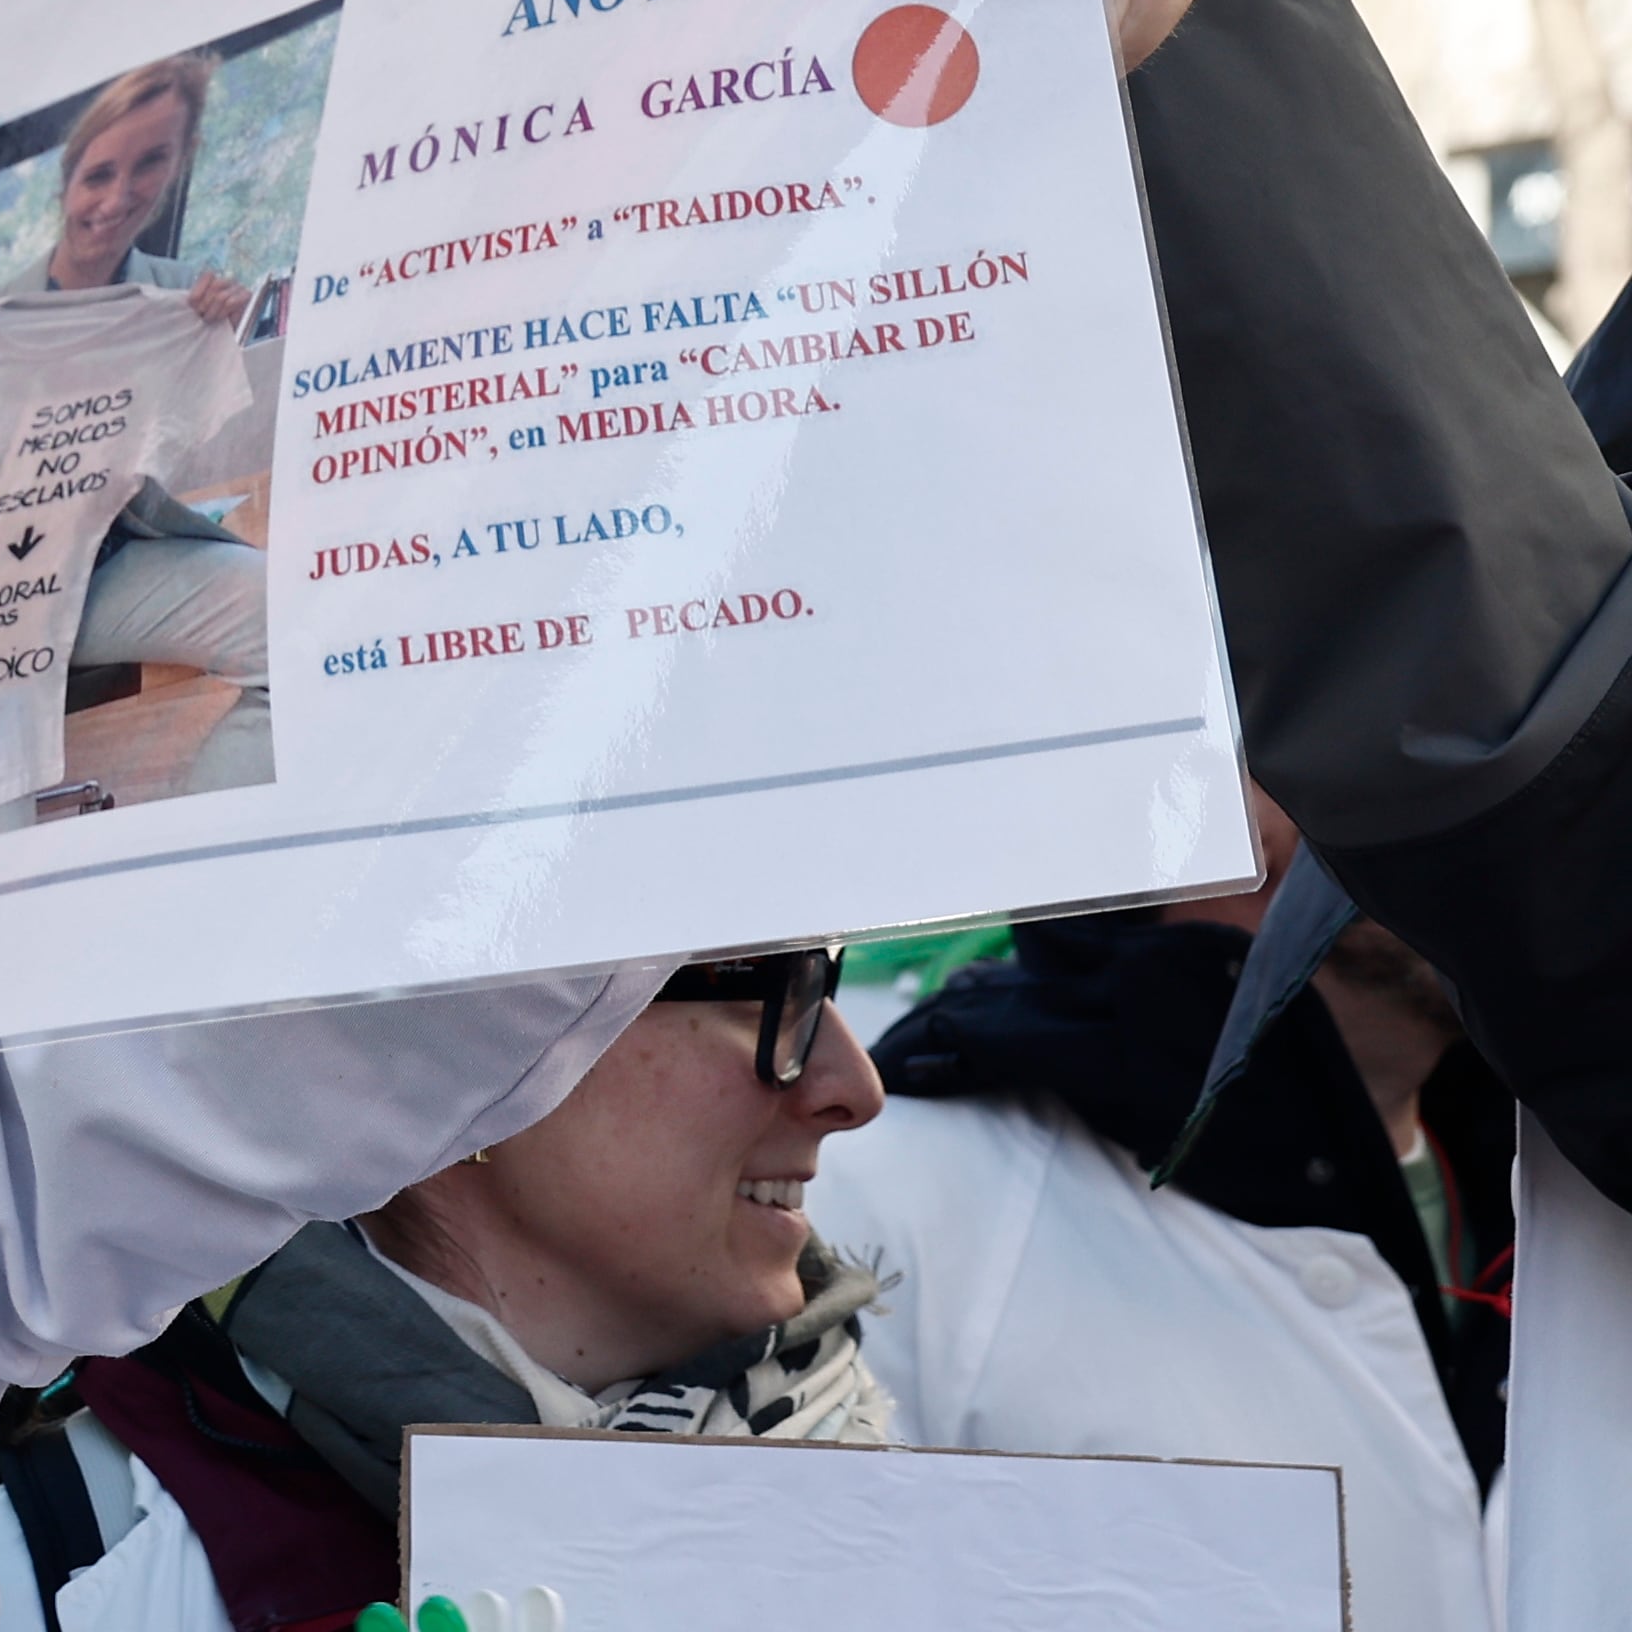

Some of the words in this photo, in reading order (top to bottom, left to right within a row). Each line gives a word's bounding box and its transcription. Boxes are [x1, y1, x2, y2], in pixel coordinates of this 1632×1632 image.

[356, 97, 595, 190] MÓNICA
[640, 47, 835, 119] GARCÍA
[312, 274, 350, 305] De
[359, 215, 578, 288] “ACTIVISTA”
[587, 218, 604, 241] a
[293, 325, 513, 399] SOLAMENTE
[524, 307, 631, 350] HACE
[642, 290, 770, 334] FALTA
[776, 278, 857, 314] “UN
[869, 250, 1031, 306] SILLÓN
[31, 387, 133, 429] SOMOS
[313, 362, 579, 440] MINISTERIAL”
[590, 359, 669, 398] para
[679, 321, 907, 377] “CAMBIAR
[916, 311, 976, 350] DE
[36, 452, 81, 479] NO
[311, 422, 500, 486] OPINIÓN”,
[509, 424, 547, 451] en
[557, 400, 698, 446] MEDIA
[704, 384, 842, 428] HORA.
[309, 534, 442, 582] JUDAS,
[452, 528, 480, 560] A
[487, 518, 542, 555] TU
[553, 503, 685, 548] LADO,
[323, 639, 388, 676] está
[398, 622, 526, 668] LIBRE
[535, 614, 594, 651] DE
[626, 587, 816, 640] PECADO.
